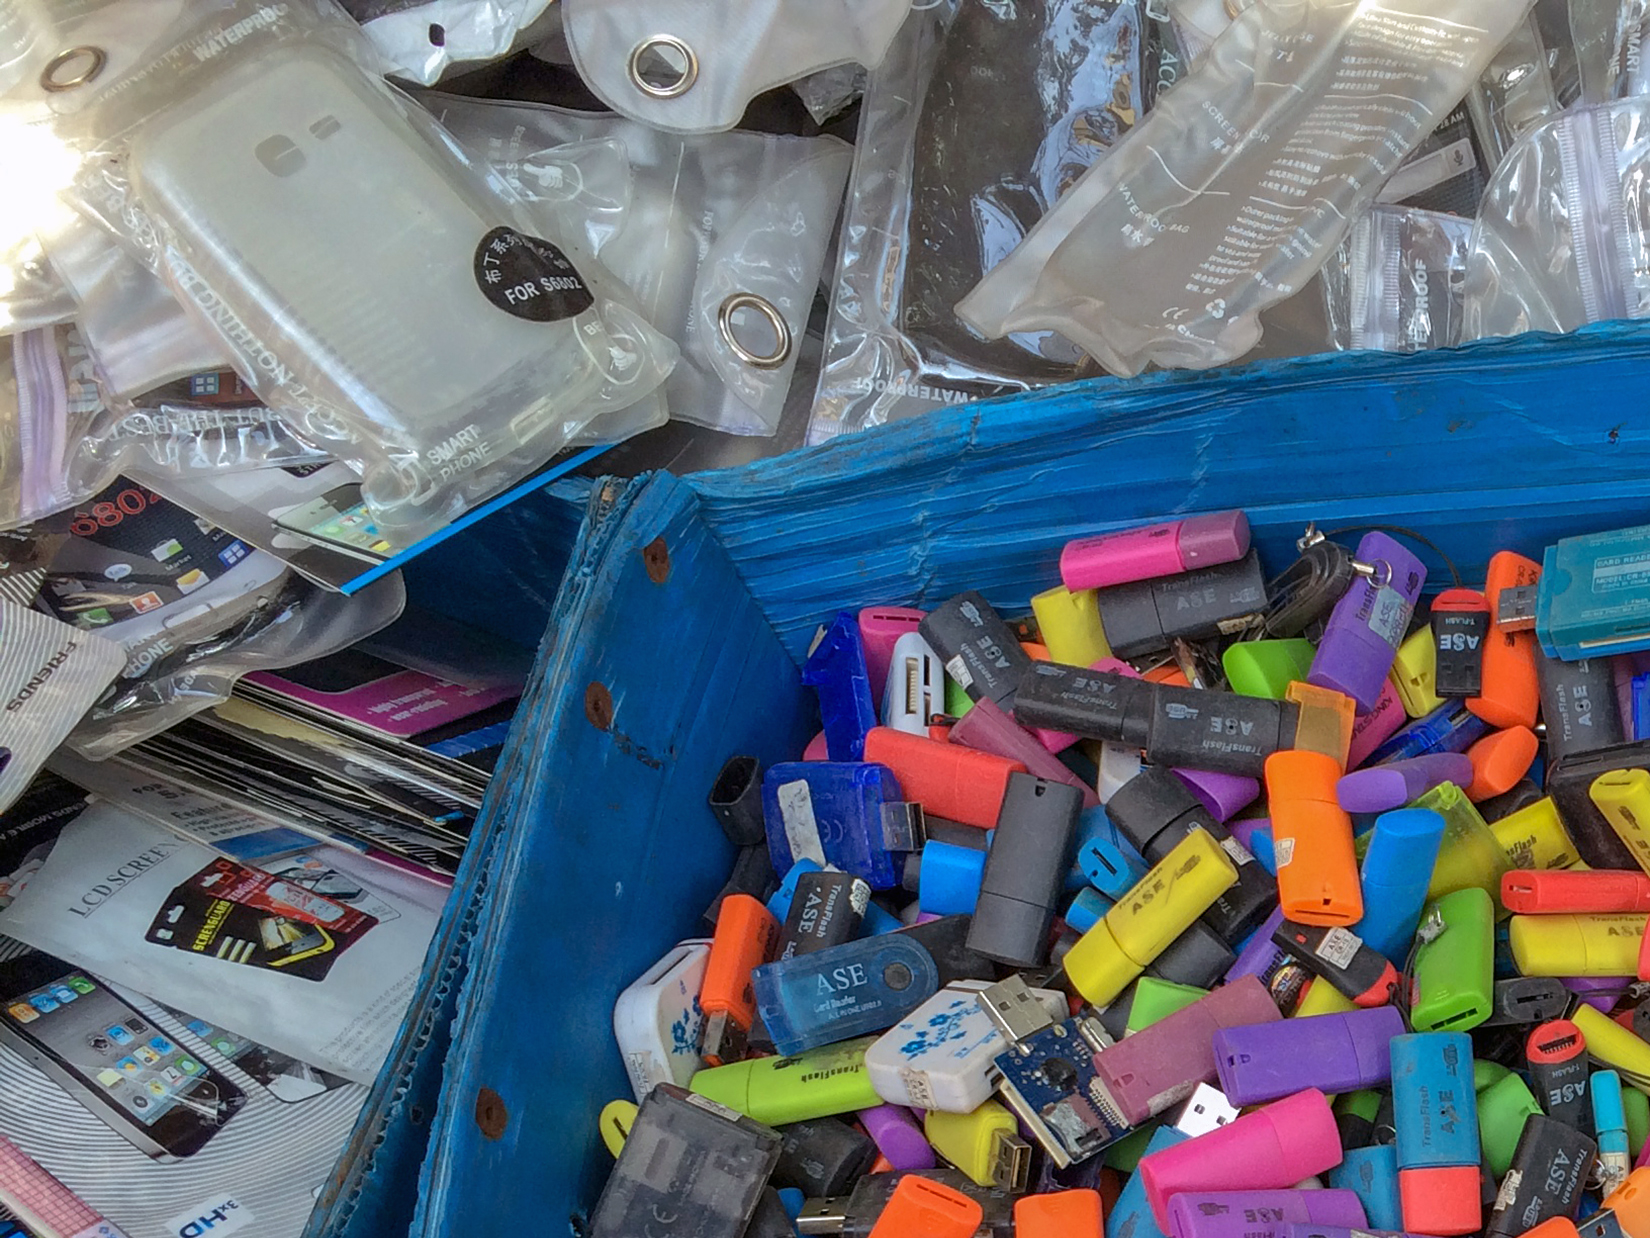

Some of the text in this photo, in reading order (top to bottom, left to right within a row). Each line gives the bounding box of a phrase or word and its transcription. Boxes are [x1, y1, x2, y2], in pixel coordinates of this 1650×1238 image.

[505, 272, 582, 306] FOR S6802
[425, 426, 483, 467] SMART
[438, 444, 495, 480] PHONE
[1596, 557, 1620, 566] CARD
[1174, 586, 1217, 611] ASE
[975, 631, 1013, 674] ASE
[1439, 633, 1479, 652] ASE
[3, 635, 79, 718] FRIENDS
[958, 638, 998, 692] TransFlash
[1074, 676, 1117, 696] ASE
[1555, 682, 1572, 740] TransFlash
[1573, 684, 1595, 727] ASE
[1209, 714, 1255, 736] ASE
[1202, 739, 1262, 756] TransFlash
[64, 878, 116, 922] LCD
[797, 890, 824, 935] ASE
[815, 881, 843, 940] TransFlash
[1127, 878, 1168, 916] ASE
[813, 962, 870, 996] ASE
[799, 1063, 860, 1084] TransFlash
[1547, 1077, 1590, 1109] ASE
[1543, 1148, 1572, 1196] ASE
[1560, 1149, 1588, 1206] TransFlash
[1244, 1208, 1284, 1223] ASE
